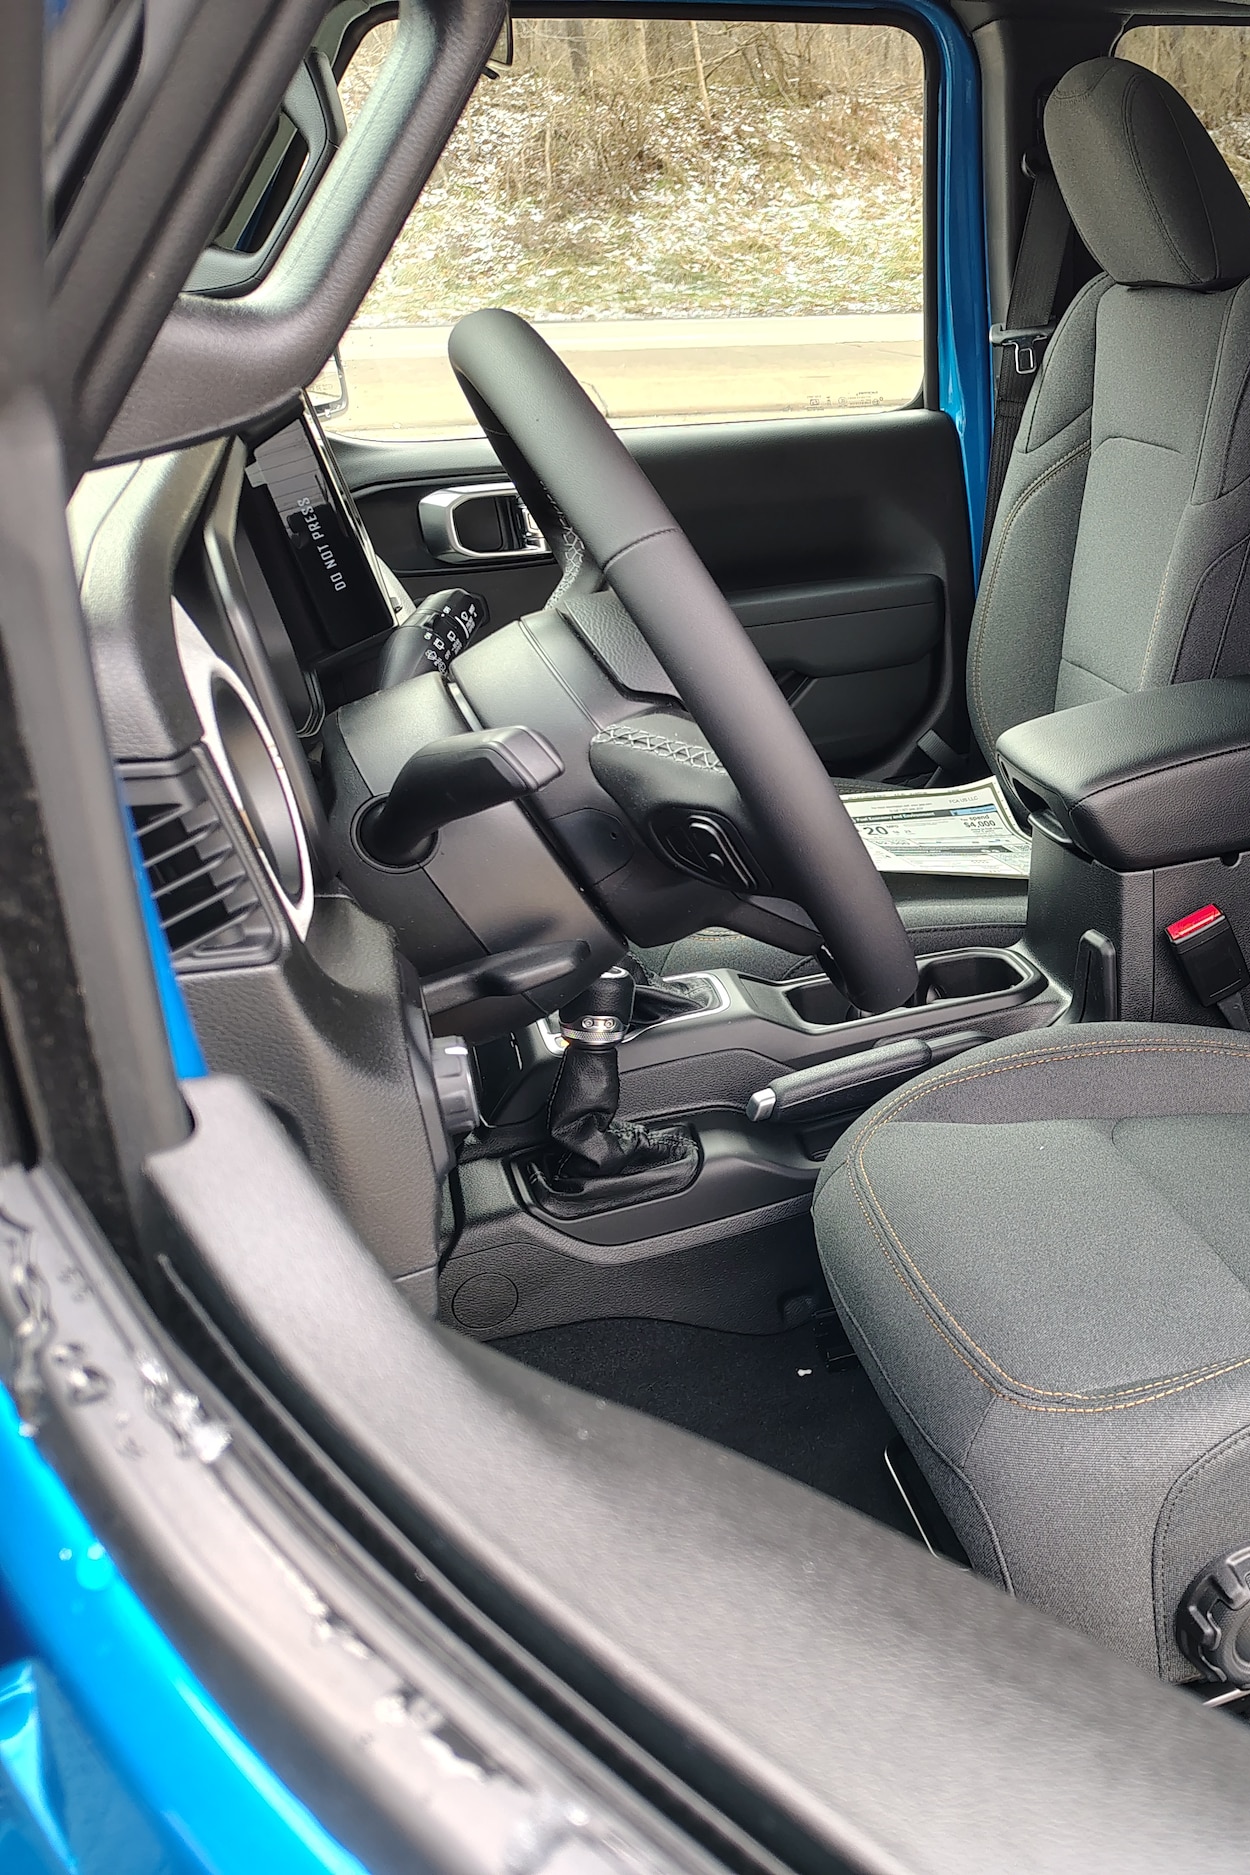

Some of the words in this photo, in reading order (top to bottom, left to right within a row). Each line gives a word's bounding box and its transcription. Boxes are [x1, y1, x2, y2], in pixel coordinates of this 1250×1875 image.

[297, 497, 325, 540] PRESS
[316, 544, 337, 570] NOT
[330, 572, 347, 592] DO
[963, 820, 996, 829] $4,000
[969, 814, 990, 823] spend
[863, 826, 888, 836] 20
